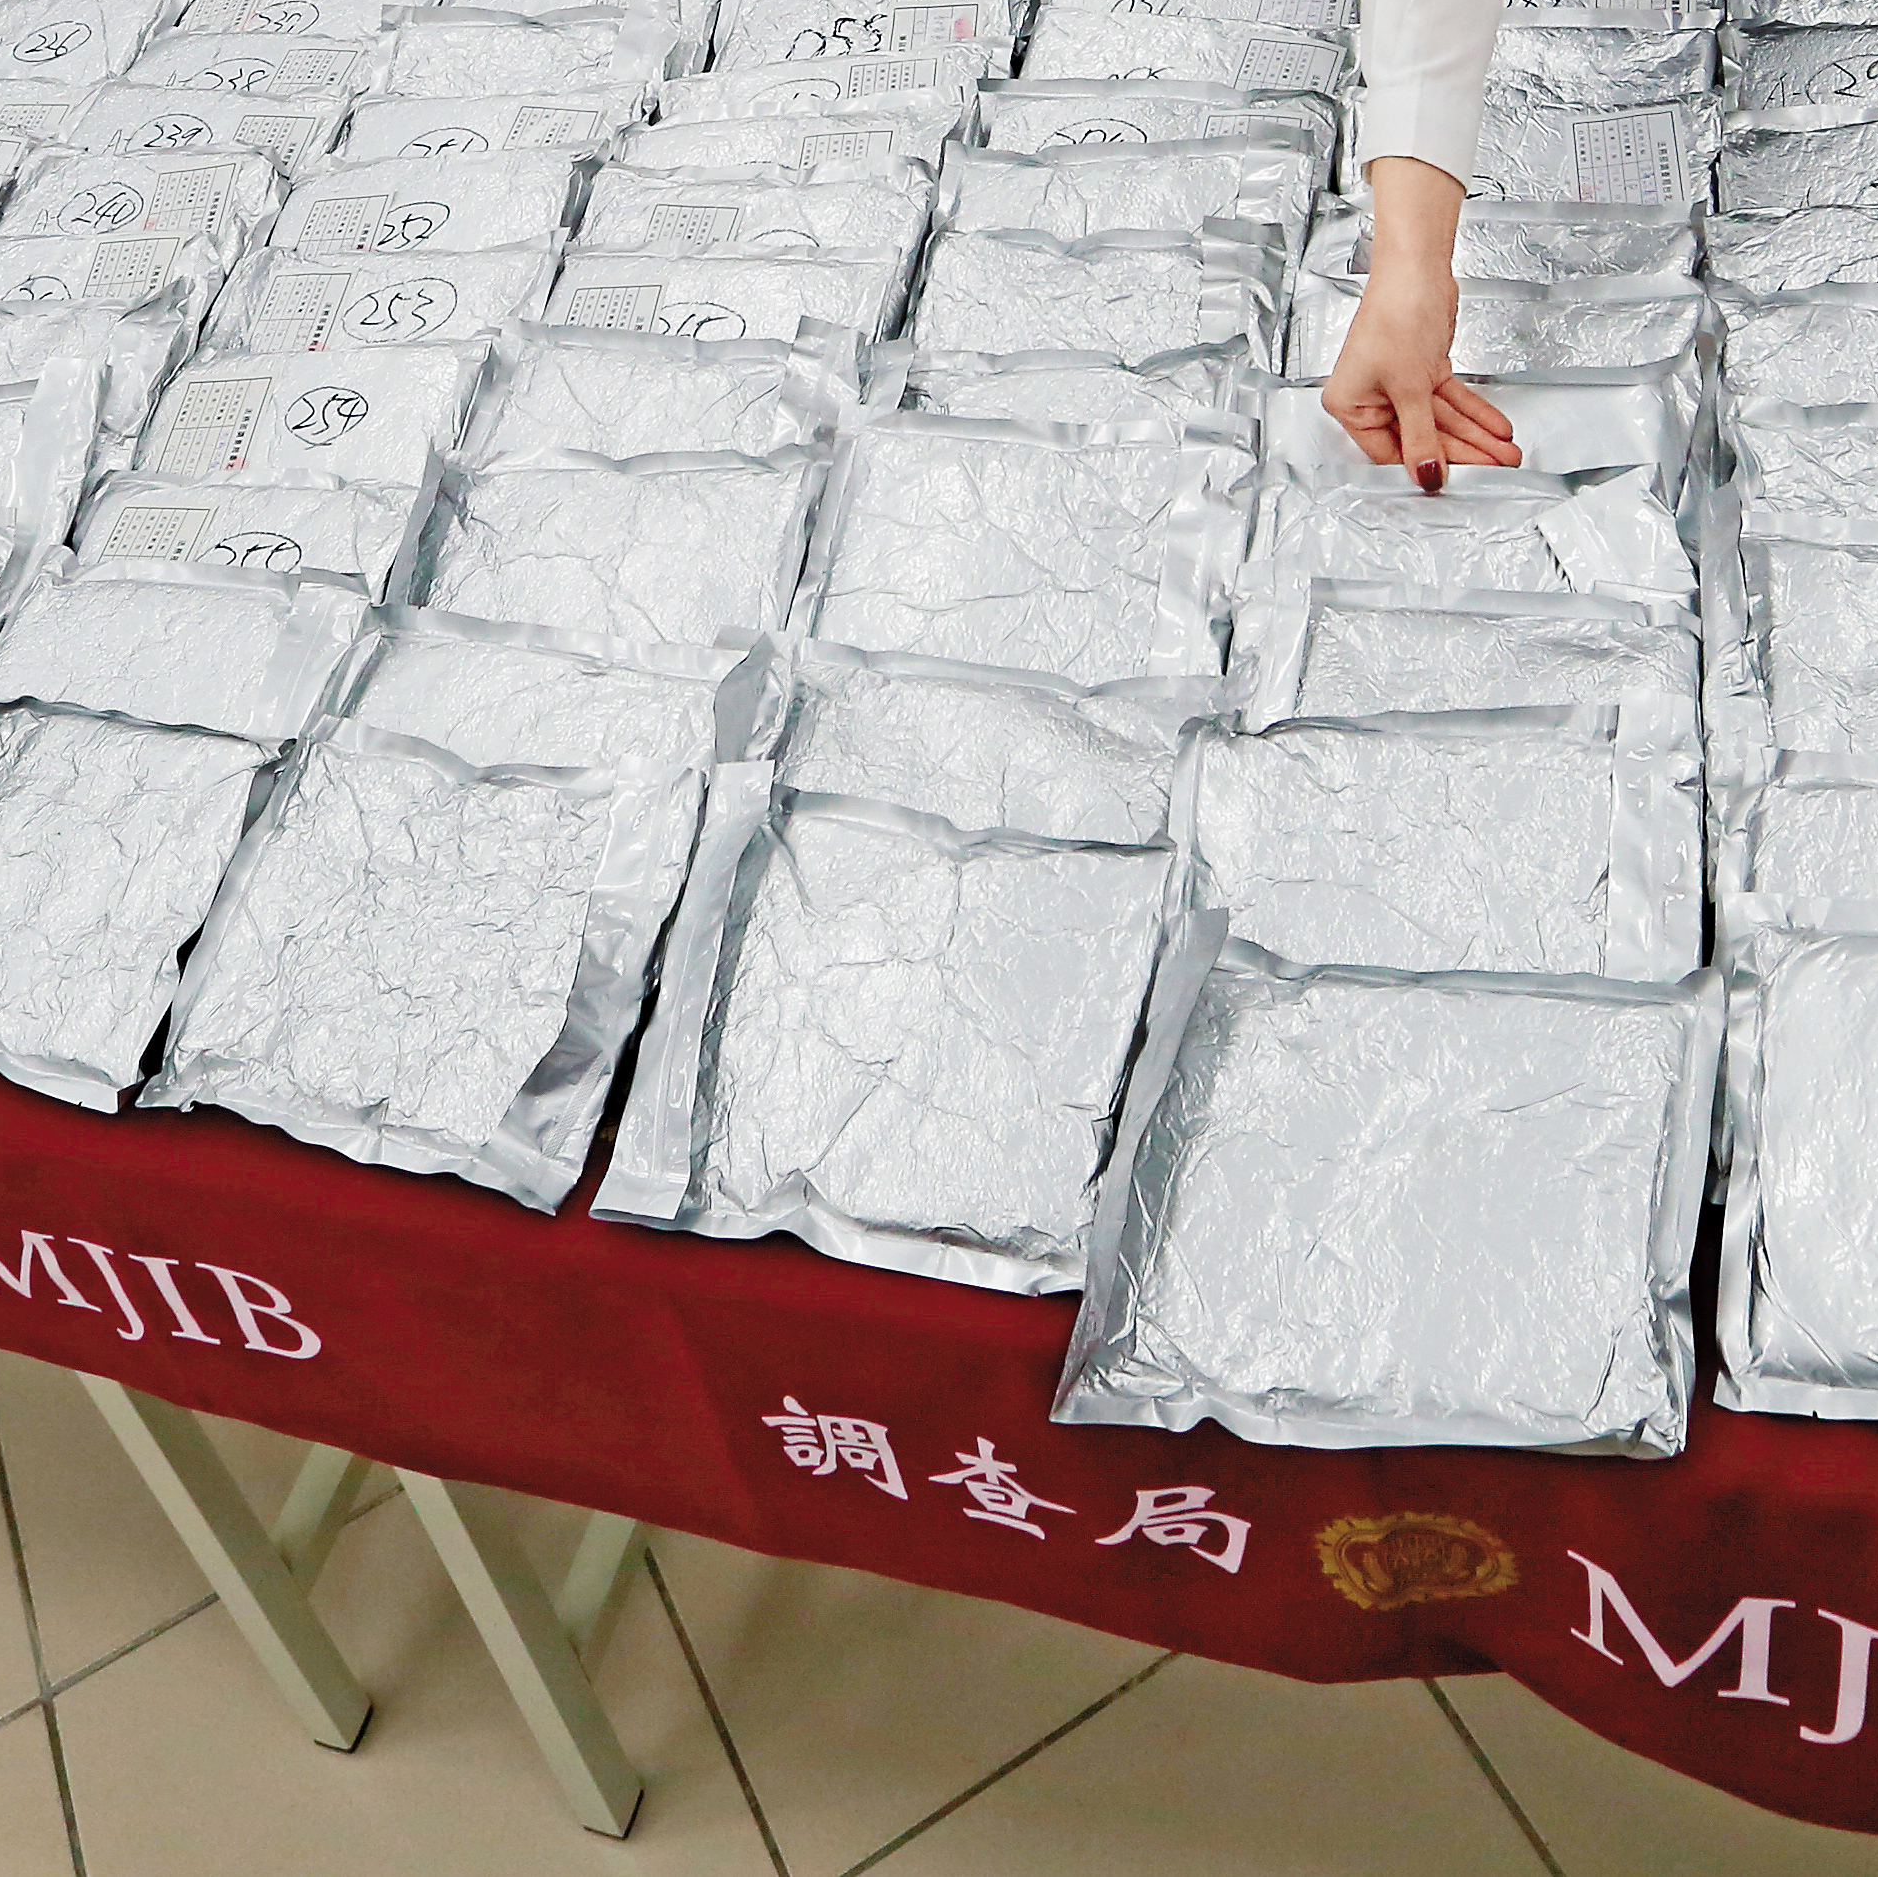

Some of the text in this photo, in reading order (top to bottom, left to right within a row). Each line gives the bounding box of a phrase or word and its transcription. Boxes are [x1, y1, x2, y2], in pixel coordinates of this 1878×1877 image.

[74, 191, 137, 224] 240
[359, 288, 435, 330] 253
[291, 390, 367, 432] 254
[761, 1396, 1249, 1574] 調查局
